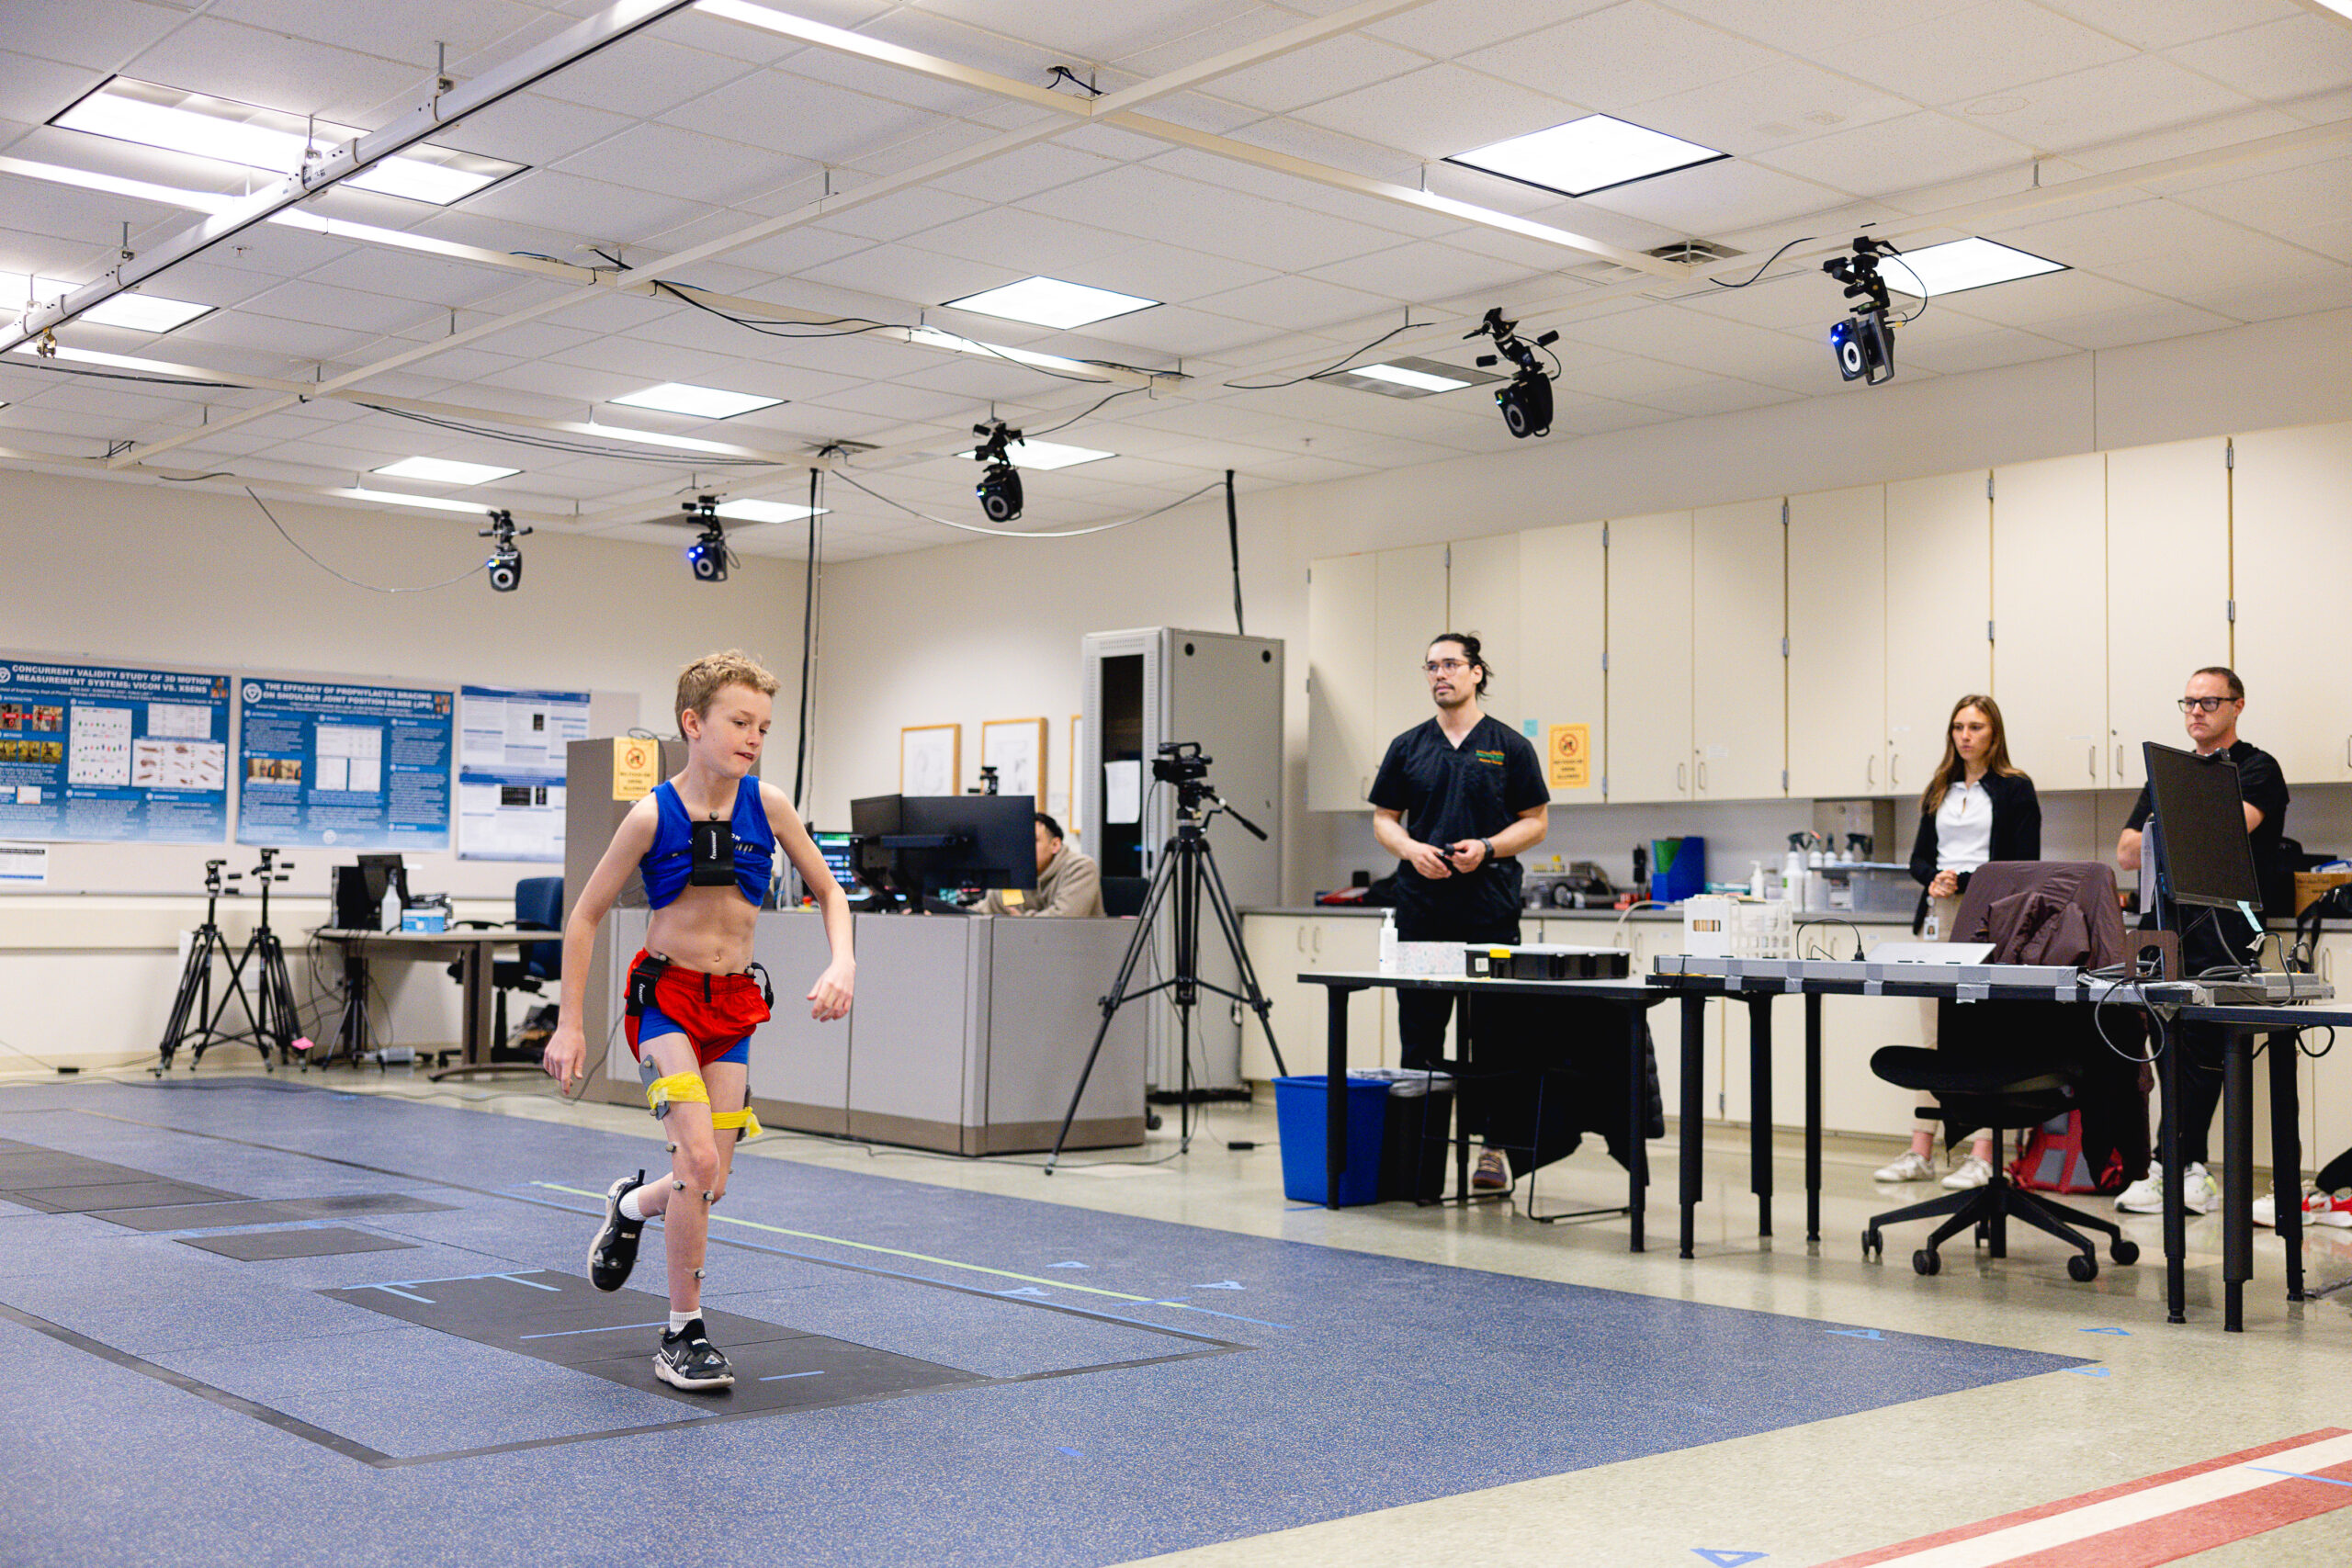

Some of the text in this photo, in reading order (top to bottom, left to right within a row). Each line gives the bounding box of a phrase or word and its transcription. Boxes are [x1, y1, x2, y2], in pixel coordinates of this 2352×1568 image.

[12, 664, 74, 676] CONCURRENT
[77, 669, 117, 678] VALIDITY
[119, 672, 148, 681] STUDY
[151, 674, 162, 682] OF
[177, 676, 211, 686] MOTION
[17, 673, 85, 685] MEASUREMENT
[88, 679, 130, 688] SYSTEMS:
[133, 682, 161, 690] VICON
[179, 685, 207, 694] XSENS
[265, 682, 281, 690] THE
[283, 683, 322, 693] EFFICACY
[277, 692, 321, 702] SHOULDER
[322, 694, 346, 704] JOINT
[348, 697, 385, 706] POSITION
[387, 699, 412, 708] SENSE
